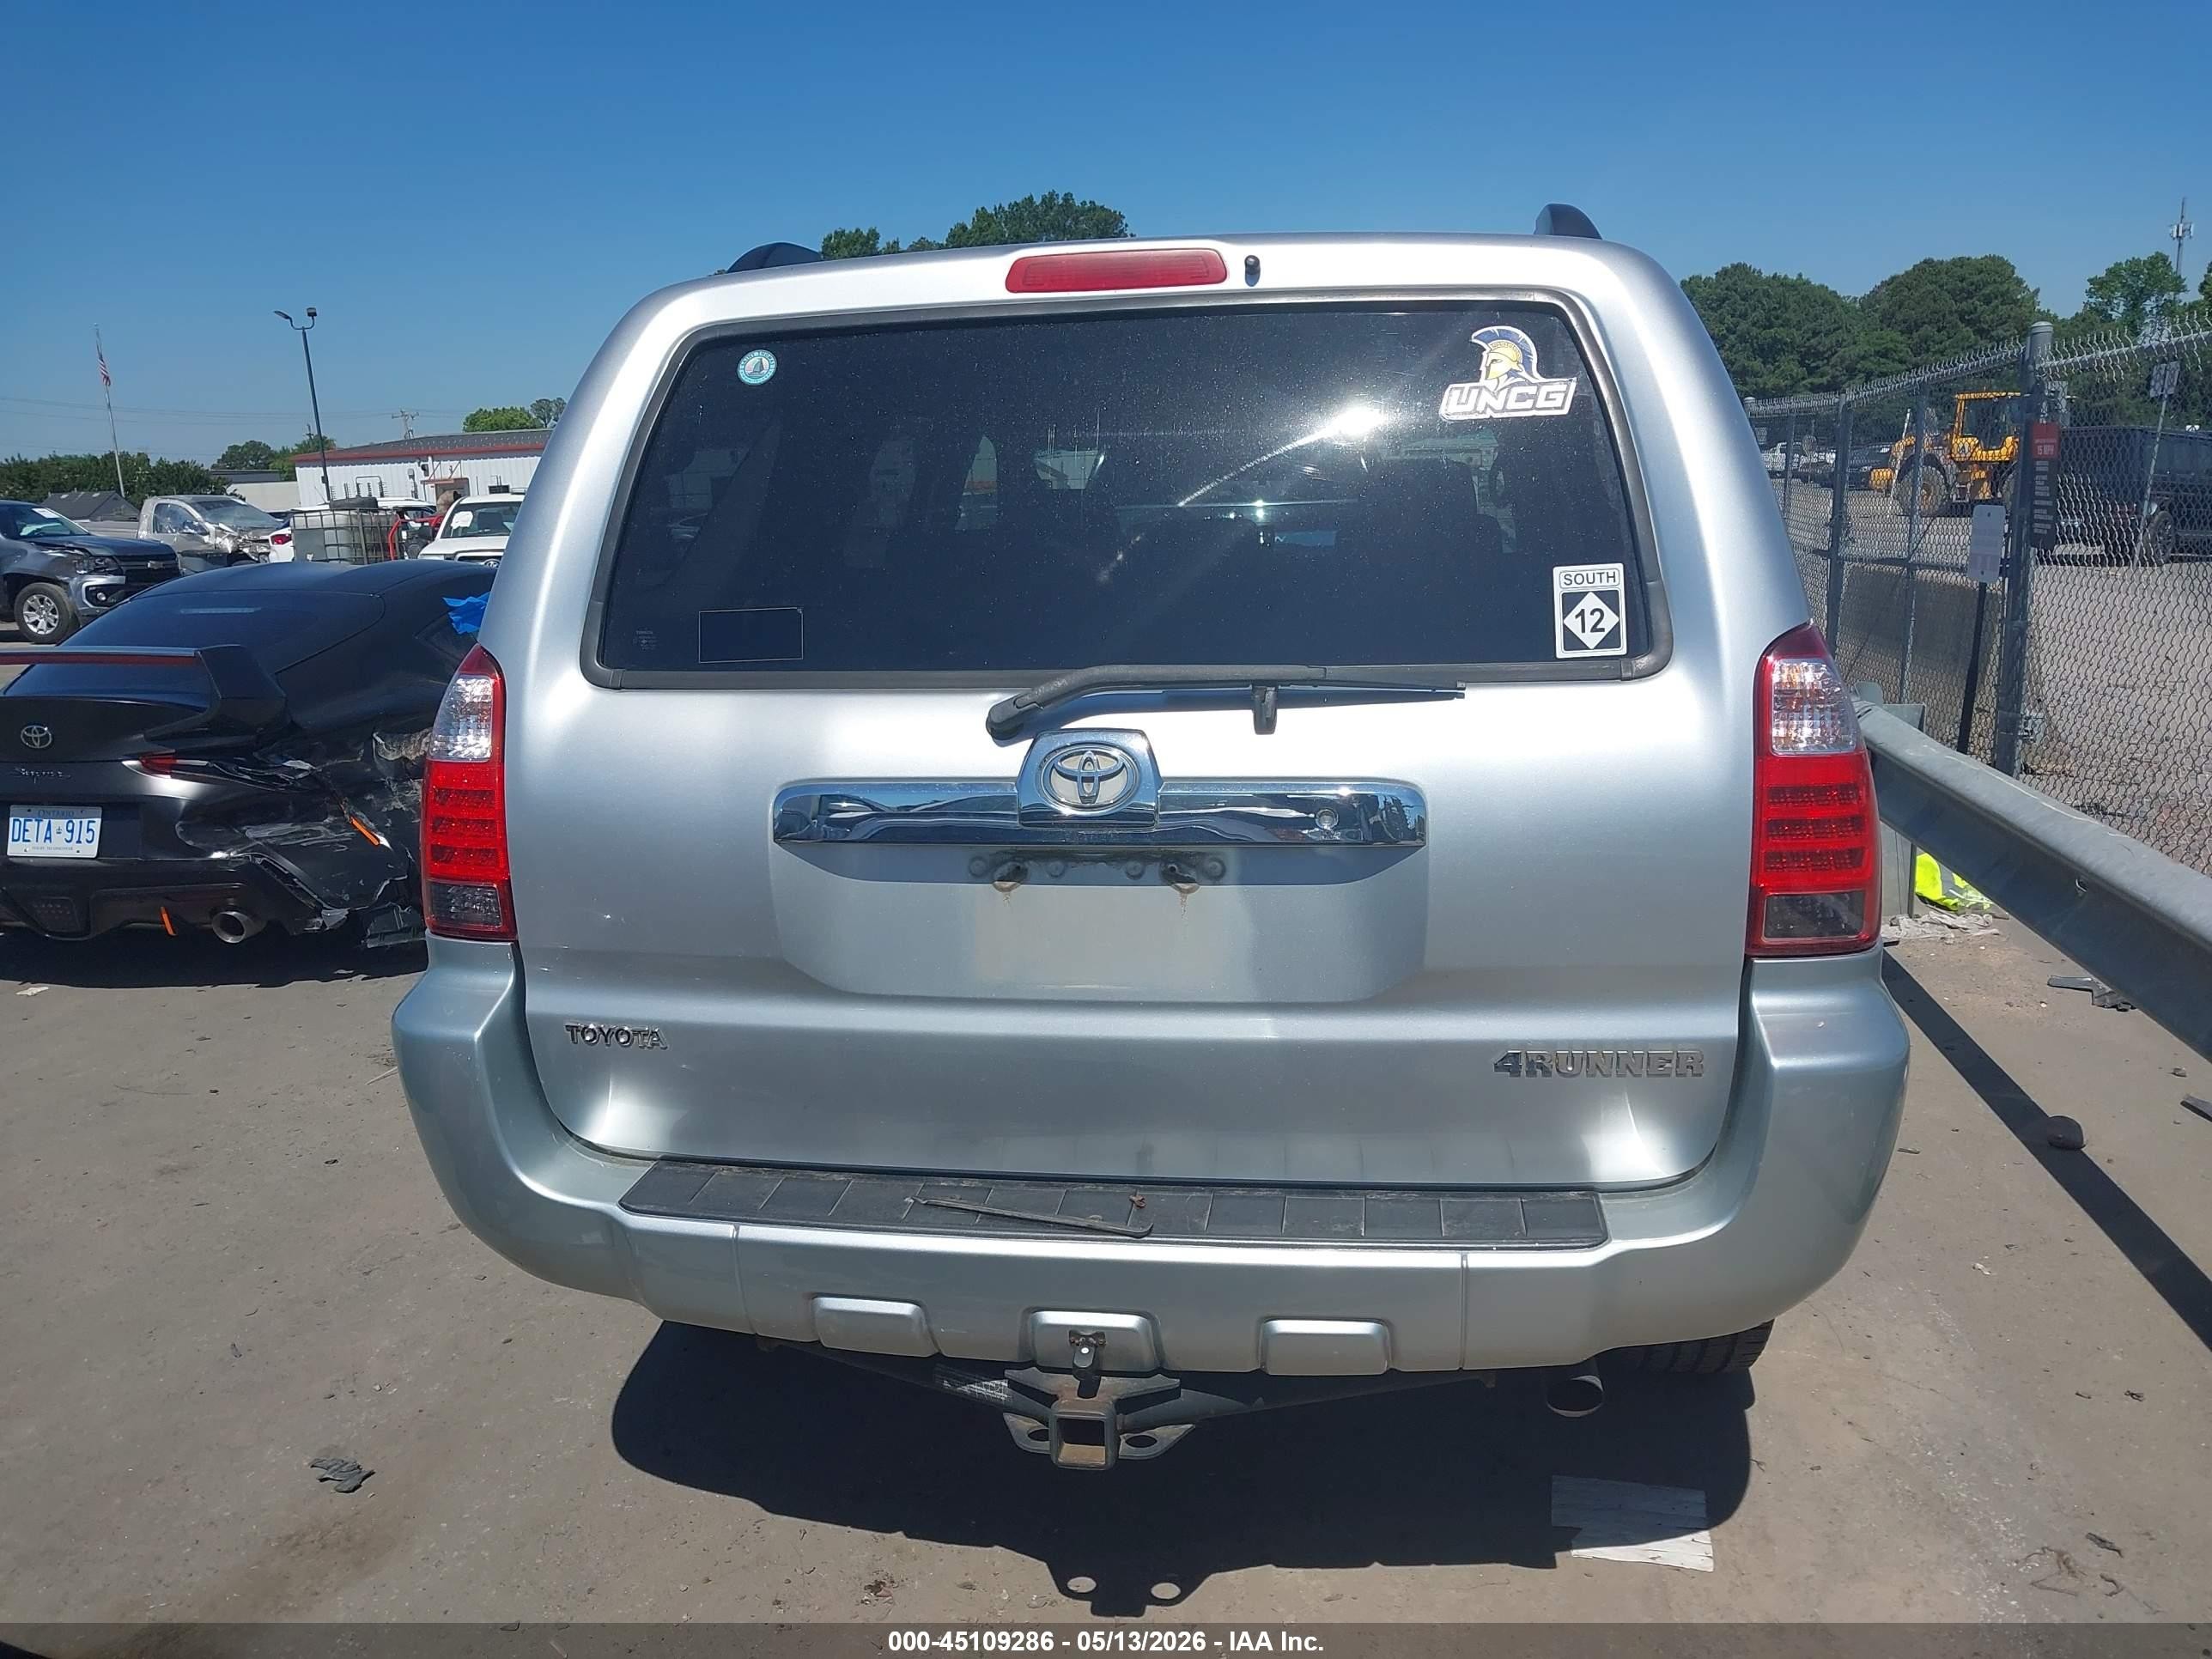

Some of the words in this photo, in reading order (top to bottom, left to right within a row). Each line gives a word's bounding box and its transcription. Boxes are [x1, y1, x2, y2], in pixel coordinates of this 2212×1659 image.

[1444, 383, 1571, 416] UNCG
[1563, 571, 1616, 586] SOUTH
[1574, 607, 1606, 634] 12
[565, 1023, 668, 1049] TOYOTA
[1493, 1050, 1705, 1079] 4RUNNER
